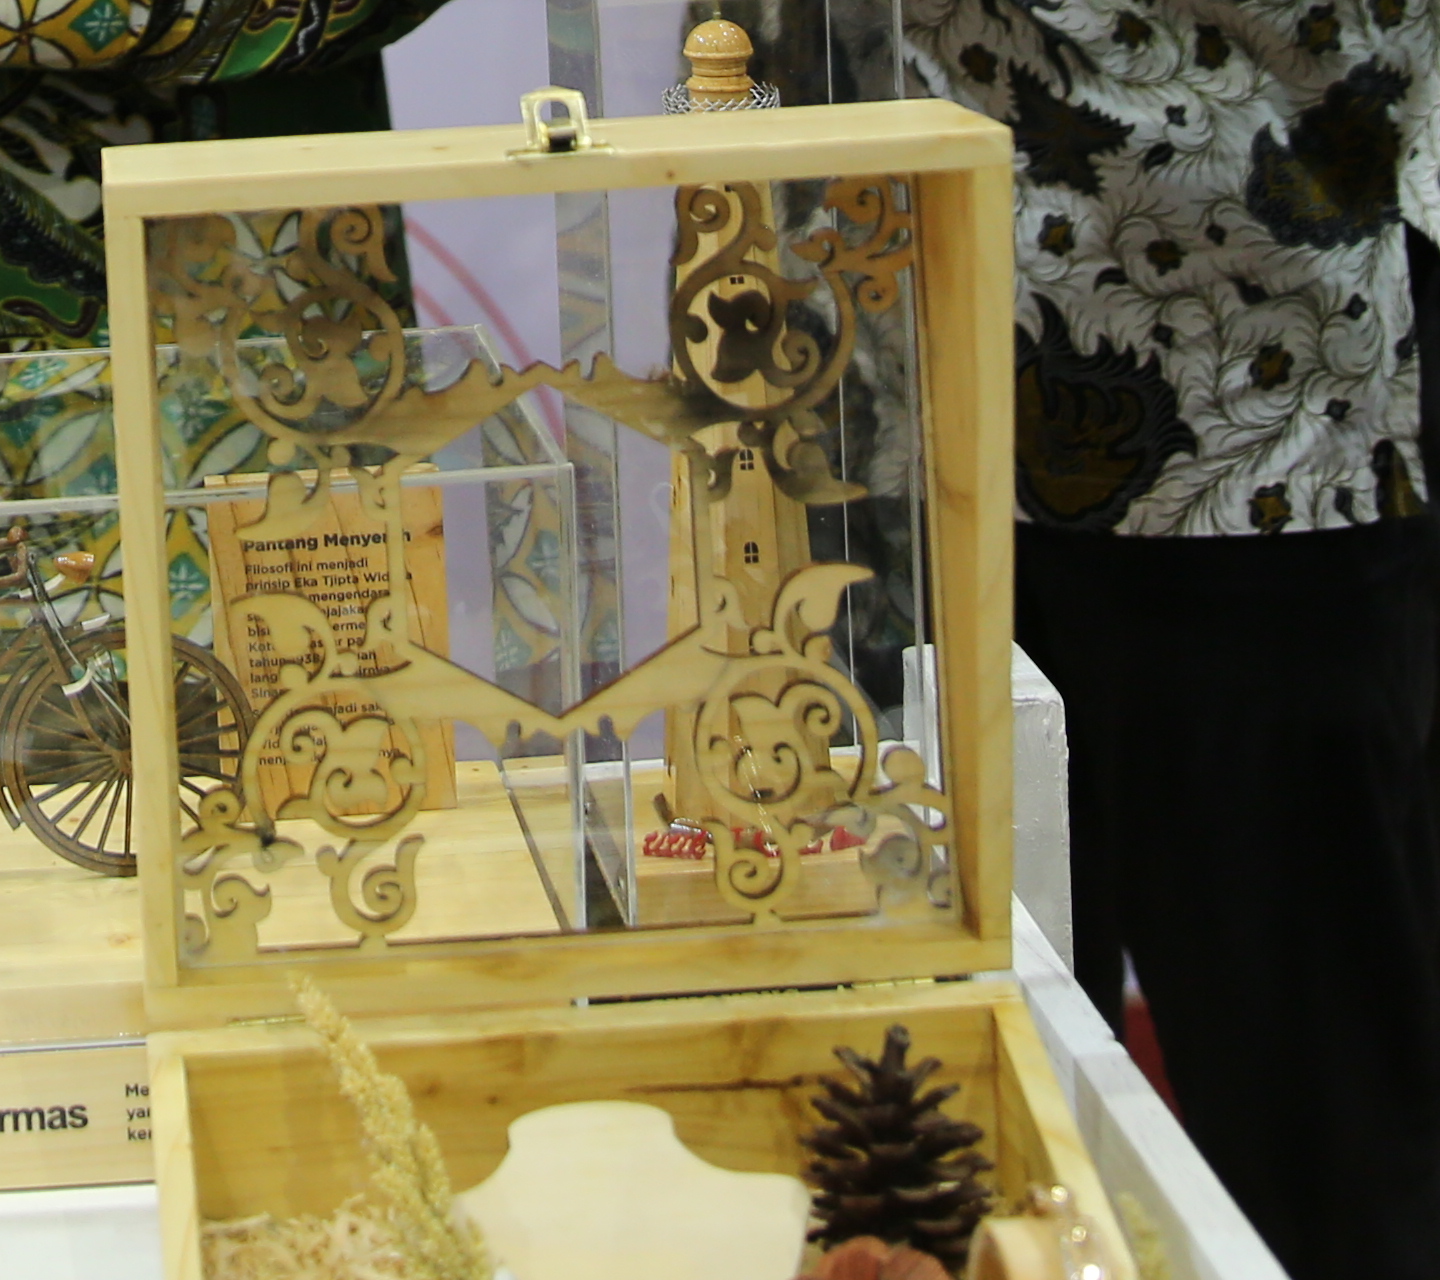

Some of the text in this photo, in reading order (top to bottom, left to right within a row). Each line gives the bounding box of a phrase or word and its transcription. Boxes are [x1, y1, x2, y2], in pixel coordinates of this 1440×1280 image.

[243, 536, 319, 552] Pantang
[245, 557, 369, 575] Filosofi ini menjadi
[245, 578, 290, 591] prinsip
[294, 577, 319, 588] Eka
[322, 574, 360, 587] Tjipta
